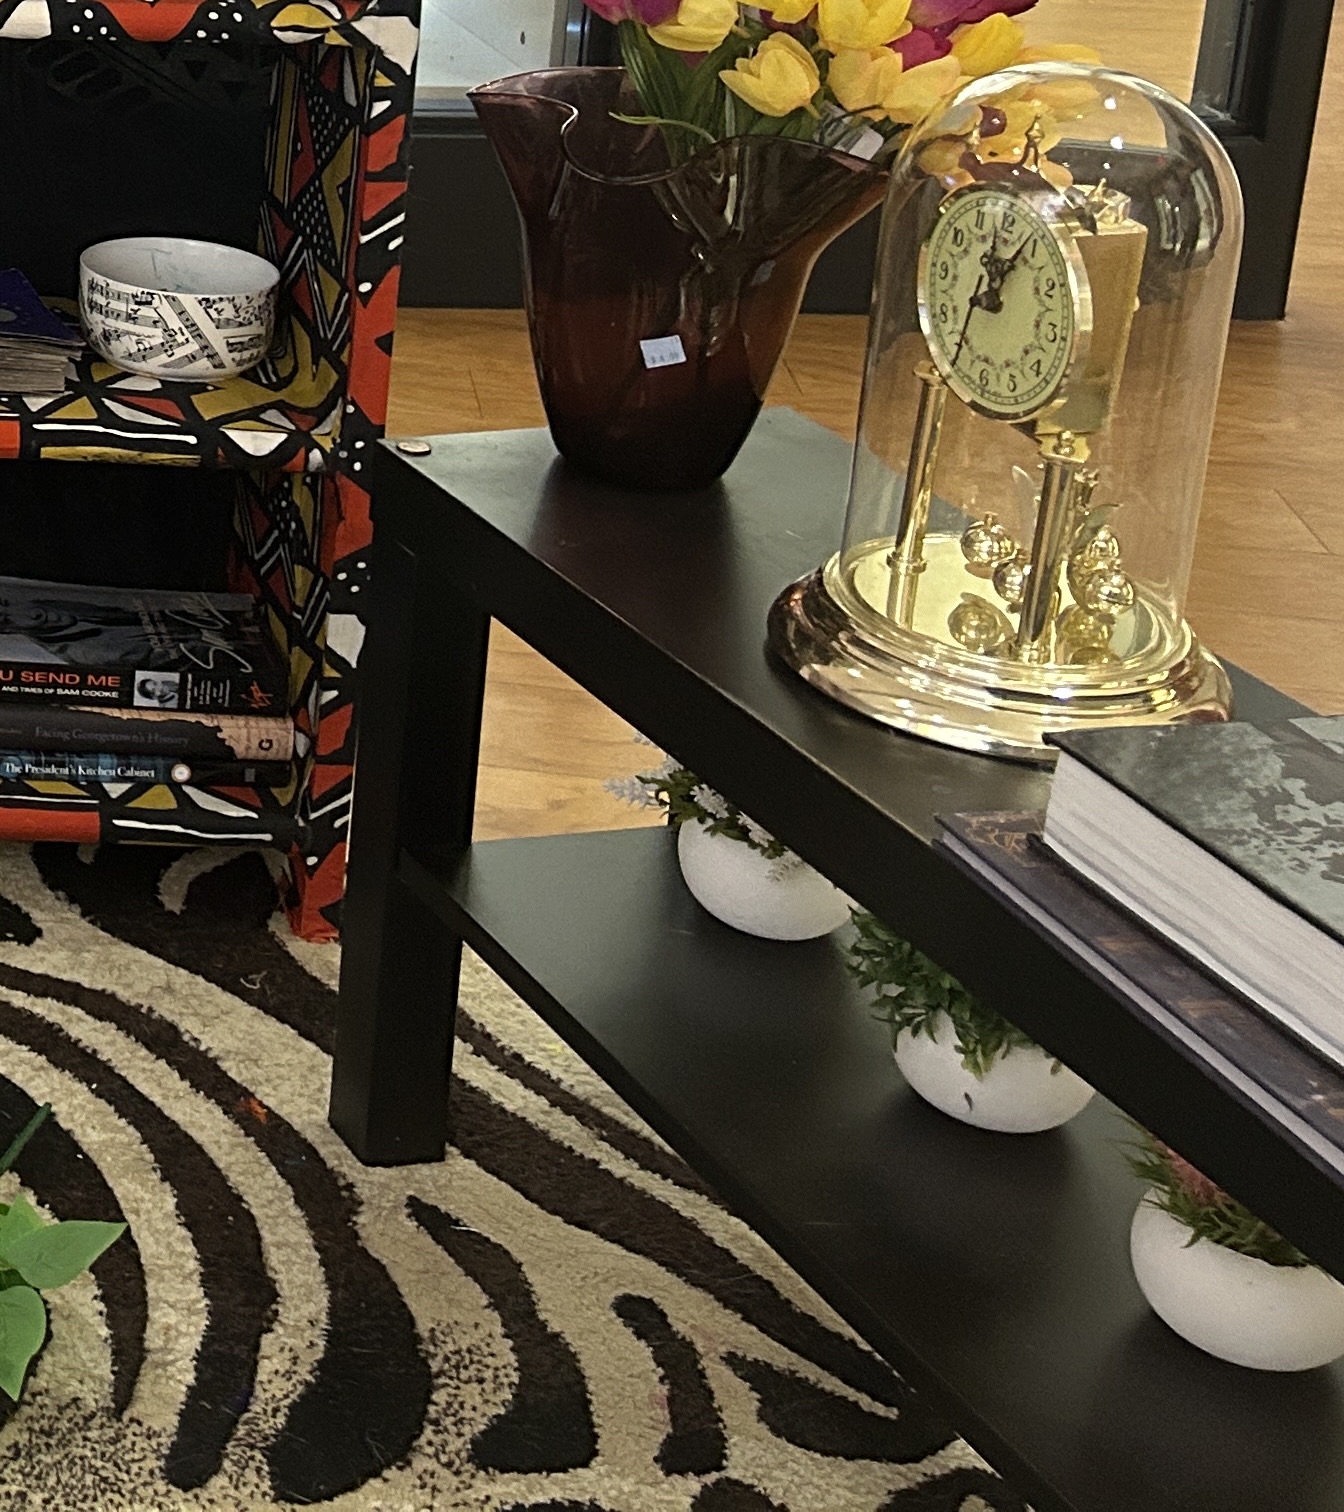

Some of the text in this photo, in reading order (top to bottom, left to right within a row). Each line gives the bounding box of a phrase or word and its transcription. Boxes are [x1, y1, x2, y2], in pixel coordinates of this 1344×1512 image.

[976, 209, 985, 230] 11
[1001, 211, 1017, 233] 12
[953, 227, 964, 247] 10
[1031, 238, 1038, 258] 1
[939, 261, 949, 280] 9
[1045, 278, 1056, 298] 2
[939, 303, 949, 324] 8
[1047, 322, 1057, 343] 3
[979, 368, 989, 387] 6
[1029, 359, 1042, 378] 4
[1007, 374, 1017, 393] 5
[20, 670, 80, 685] SEND
[87, 675, 121, 687] ME
[81, 690, 120, 699] COOKE
[35, 726, 70, 741] Facing
[4, 761, 23, 774] The
[24, 762, 76, 775] President's
[78, 765, 116, 776] Kitchen
[117, 765, 155, 777] Cabinet
